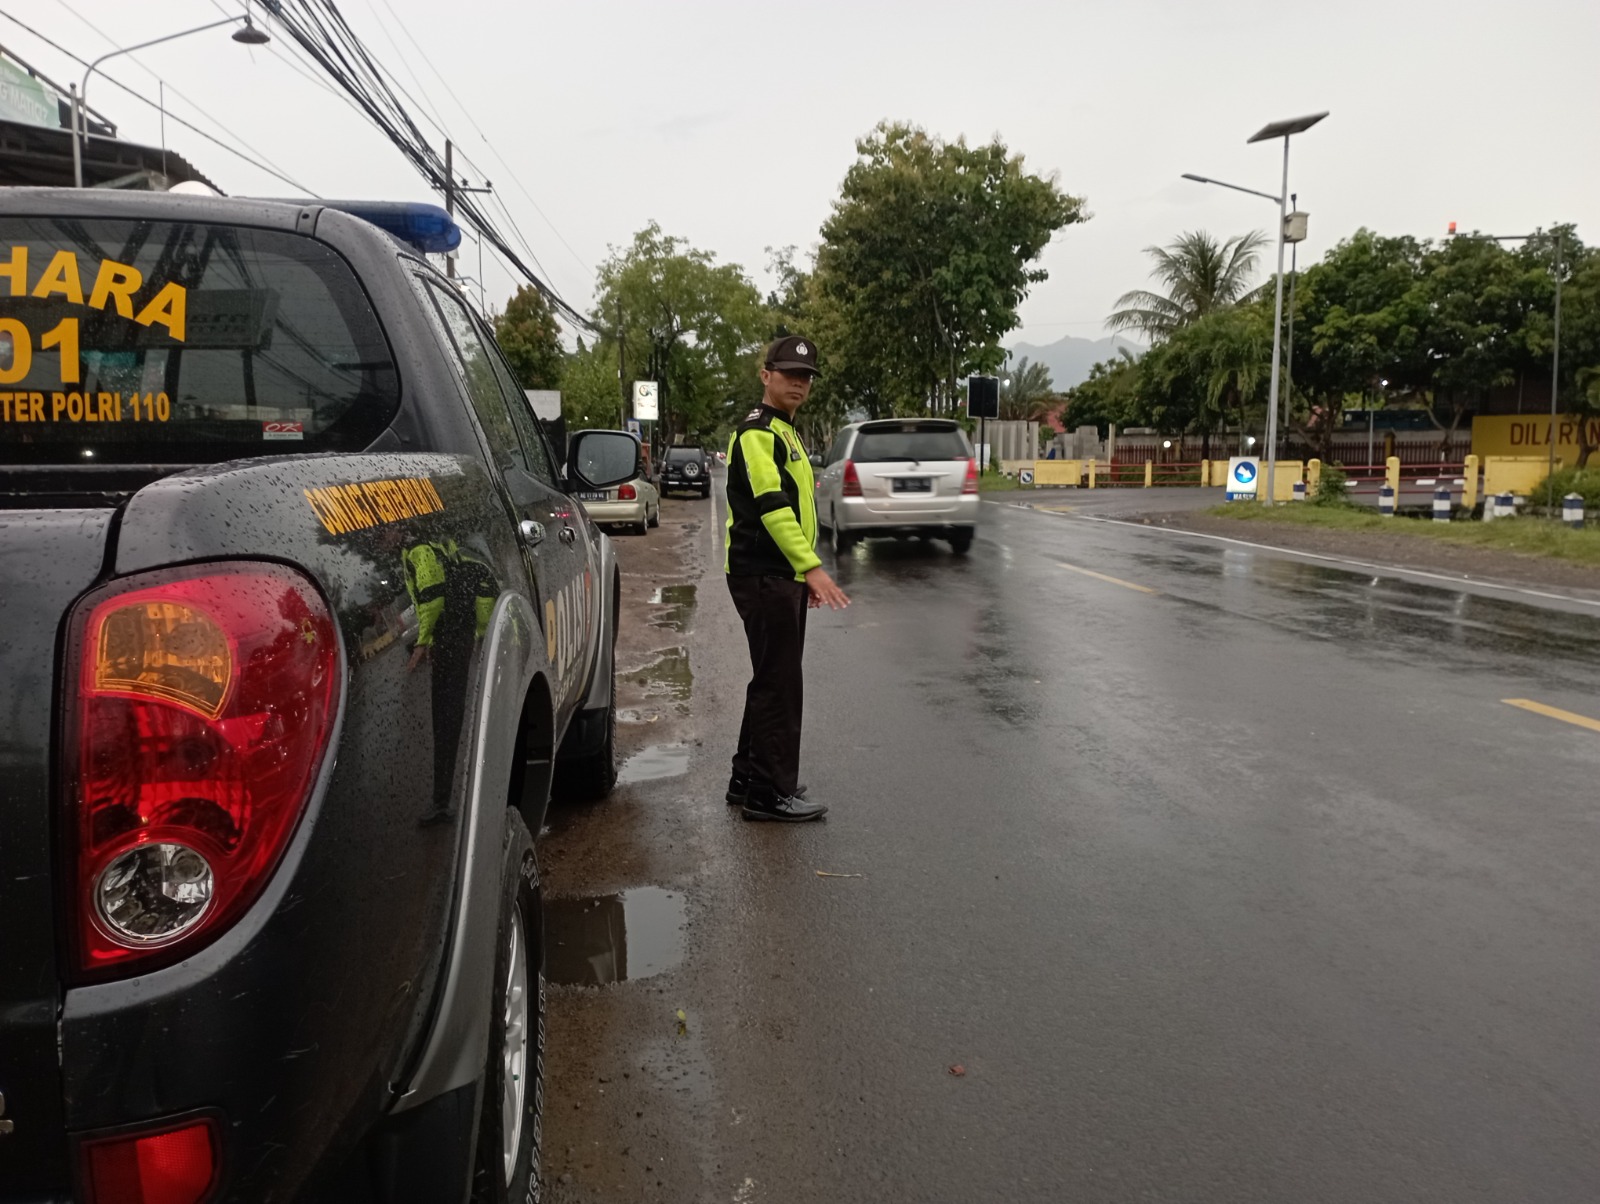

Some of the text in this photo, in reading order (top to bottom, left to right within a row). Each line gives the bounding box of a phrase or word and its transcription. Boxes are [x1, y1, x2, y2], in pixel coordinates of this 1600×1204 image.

[0, 317, 80, 384] 01
[0, 392, 170, 422] TER POLRI 110
[265, 423, 301, 432] OK
[1510, 422, 1600, 446] DILARN
[303, 484, 379, 536] CONTACT
[361, 480, 414, 524] CENTER
[396, 477, 434, 517] POLRI
[545, 572, 586, 681] POLISI
